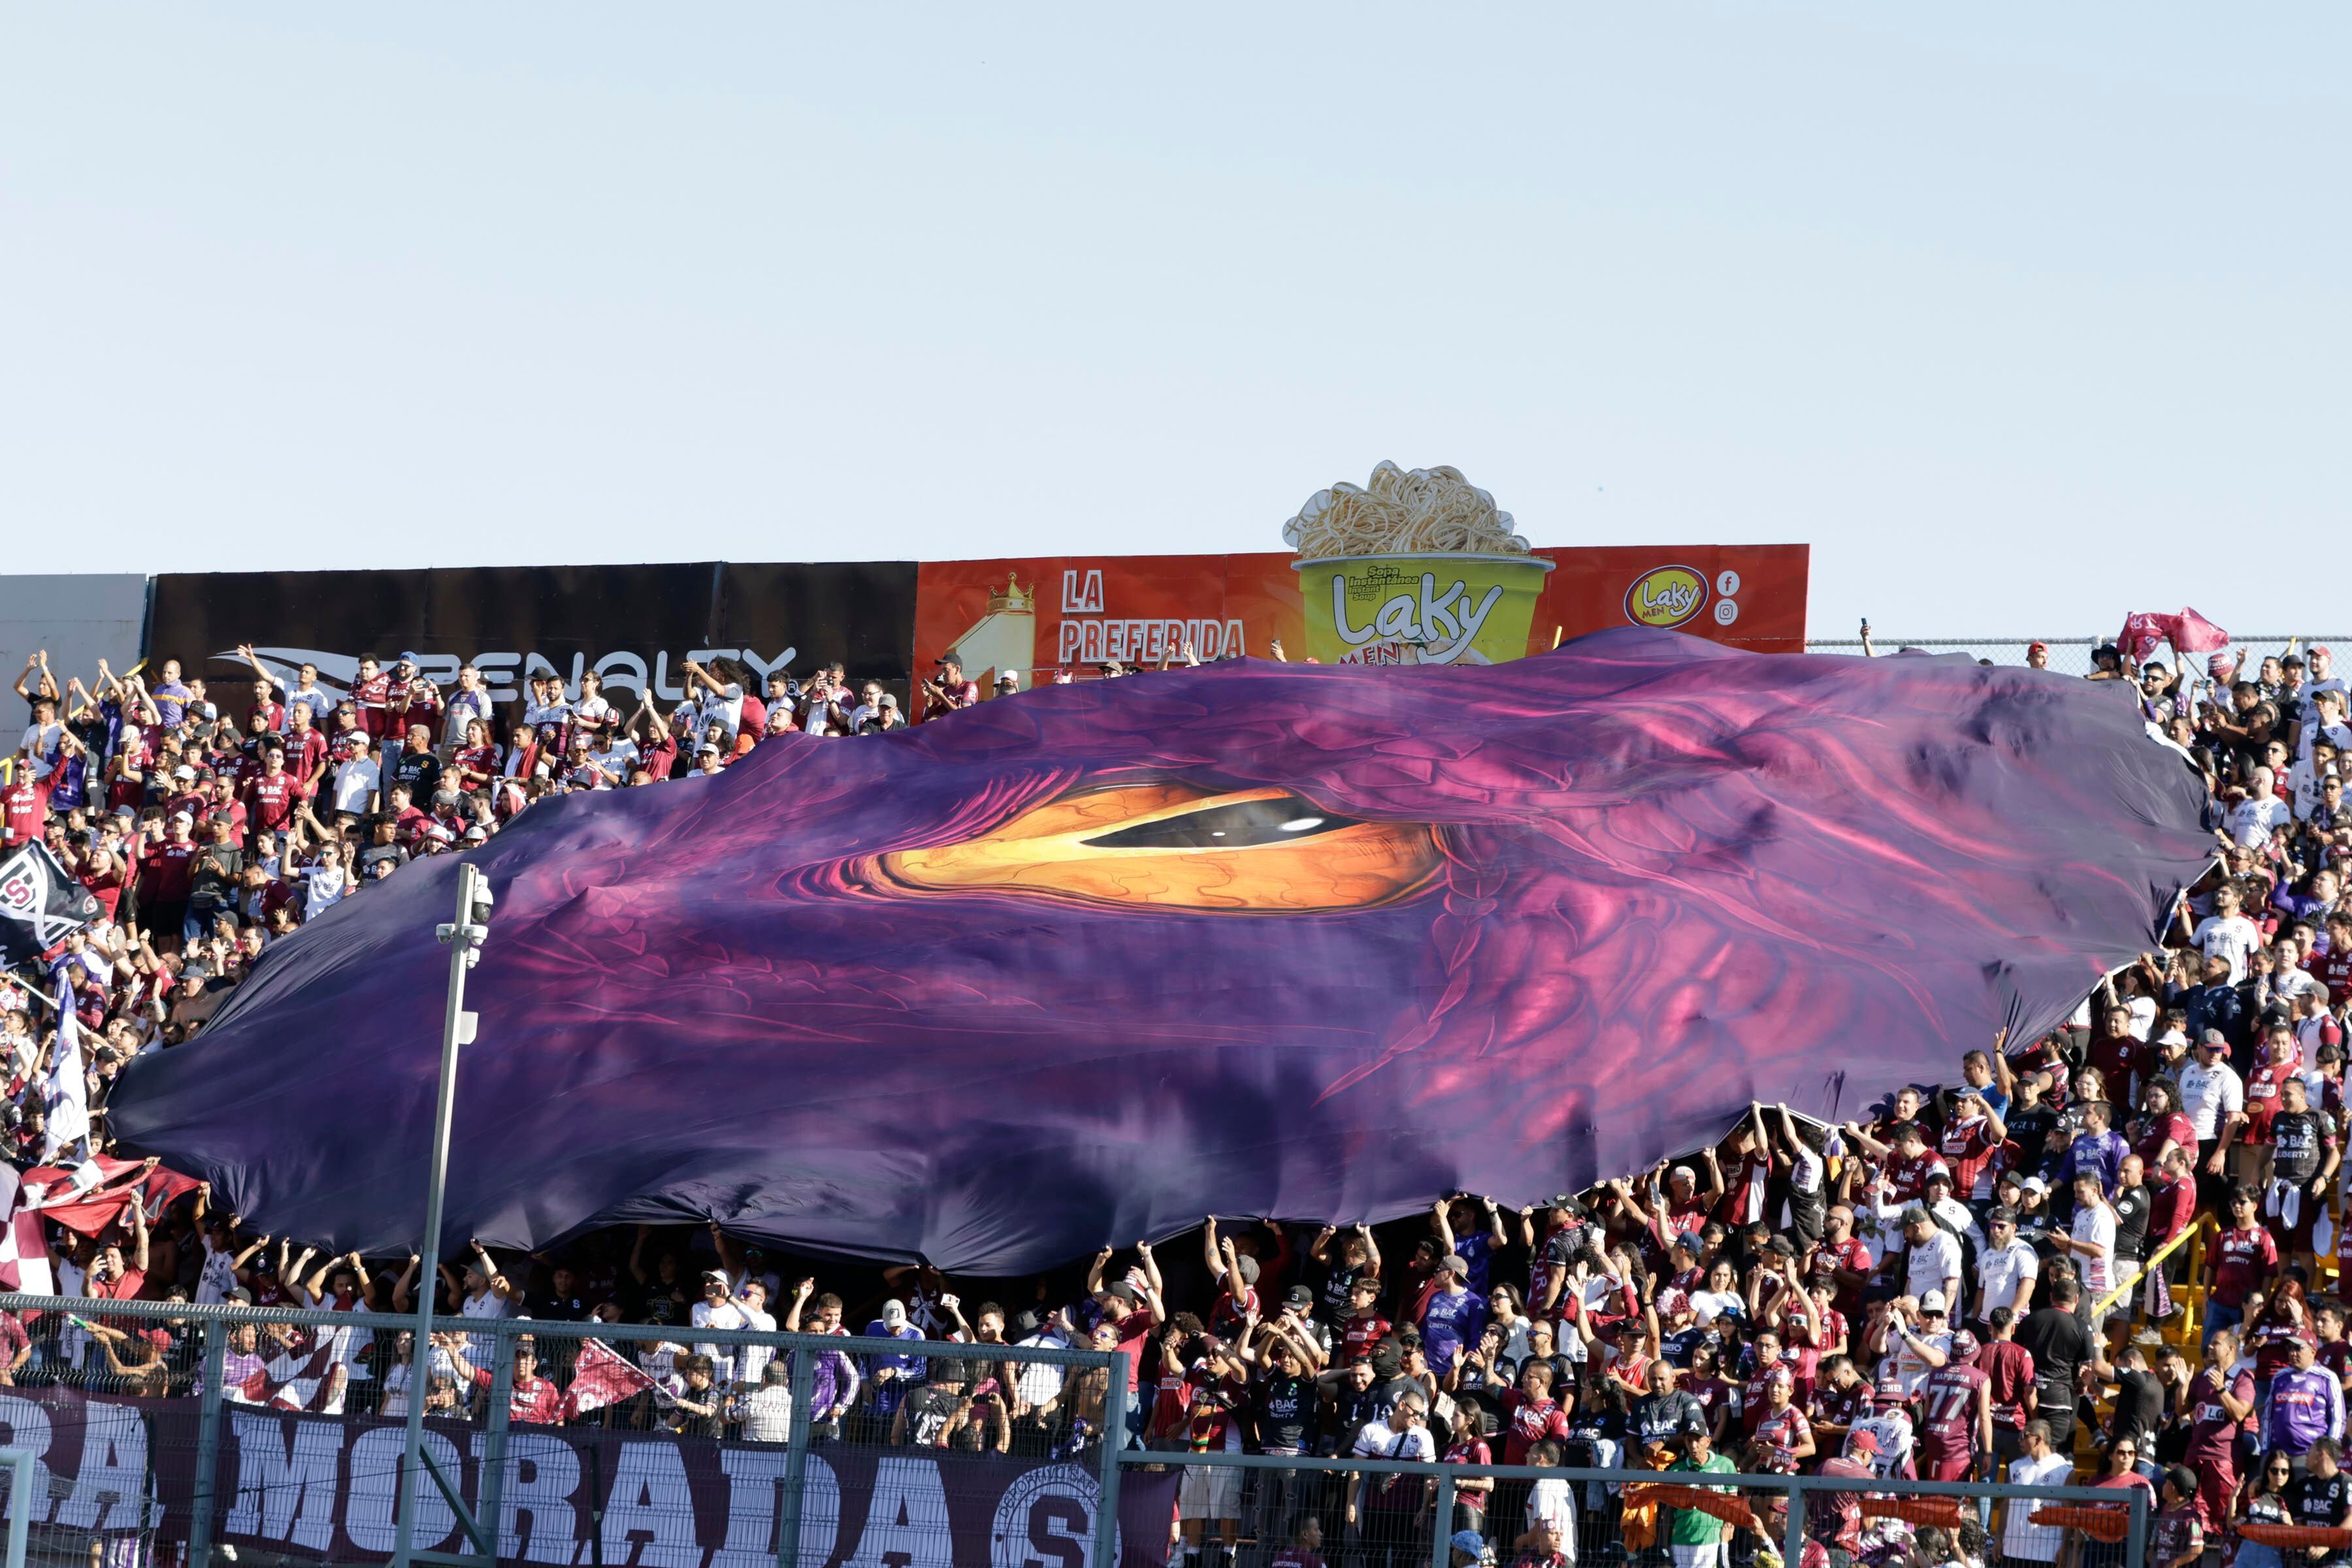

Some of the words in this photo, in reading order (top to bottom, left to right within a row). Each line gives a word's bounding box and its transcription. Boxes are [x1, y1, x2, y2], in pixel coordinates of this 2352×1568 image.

[1367, 566, 1399, 578] Sopa
[1062, 570, 1104, 612] LA
[1348, 585, 1380, 594] Instant
[1642, 580, 1699, 617] Laky
[1333, 572, 1503, 664] Laky
[1642, 607, 1665, 619] MEN
[1059, 620, 1245, 662] PREFERIDA
[406, 647, 796, 702] PENALTY
[6, 879, 29, 905] S
[2119, 1047, 2129, 1057] S
[2290, 1135, 2313, 1145] BAC
[2087, 1149, 2101, 1157] BAC
[1915, 1161, 1923, 1169] S
[1927, 1243, 1935, 1251] S
[1345, 1275, 1352, 1285] S
[572, 1299, 580, 1309] S
[1456, 1298, 1464, 1307] S
[1727, 1307, 1737, 1315] S
[1367, 1321, 1375, 1331] S
[1934, 1373, 1971, 1383] SAPRISSA
[1275, 1399, 1298, 1409] BAC
[1843, 1401, 1852, 1411] S
[1929, 1385, 1970, 1421] 77
[1525, 1411, 1544, 1425] BAC
[1654, 1420, 1678, 1431] BAC
[1577, 1428, 1599, 1437] BAC
[1389, 1443, 1417, 1454] klbi
[0, 1394, 165, 1529] RA
[999, 1465, 1065, 1518] DEPORTIVO
[2328, 1483, 2340, 1498] S
[2313, 1500, 2332, 1511] BAC
